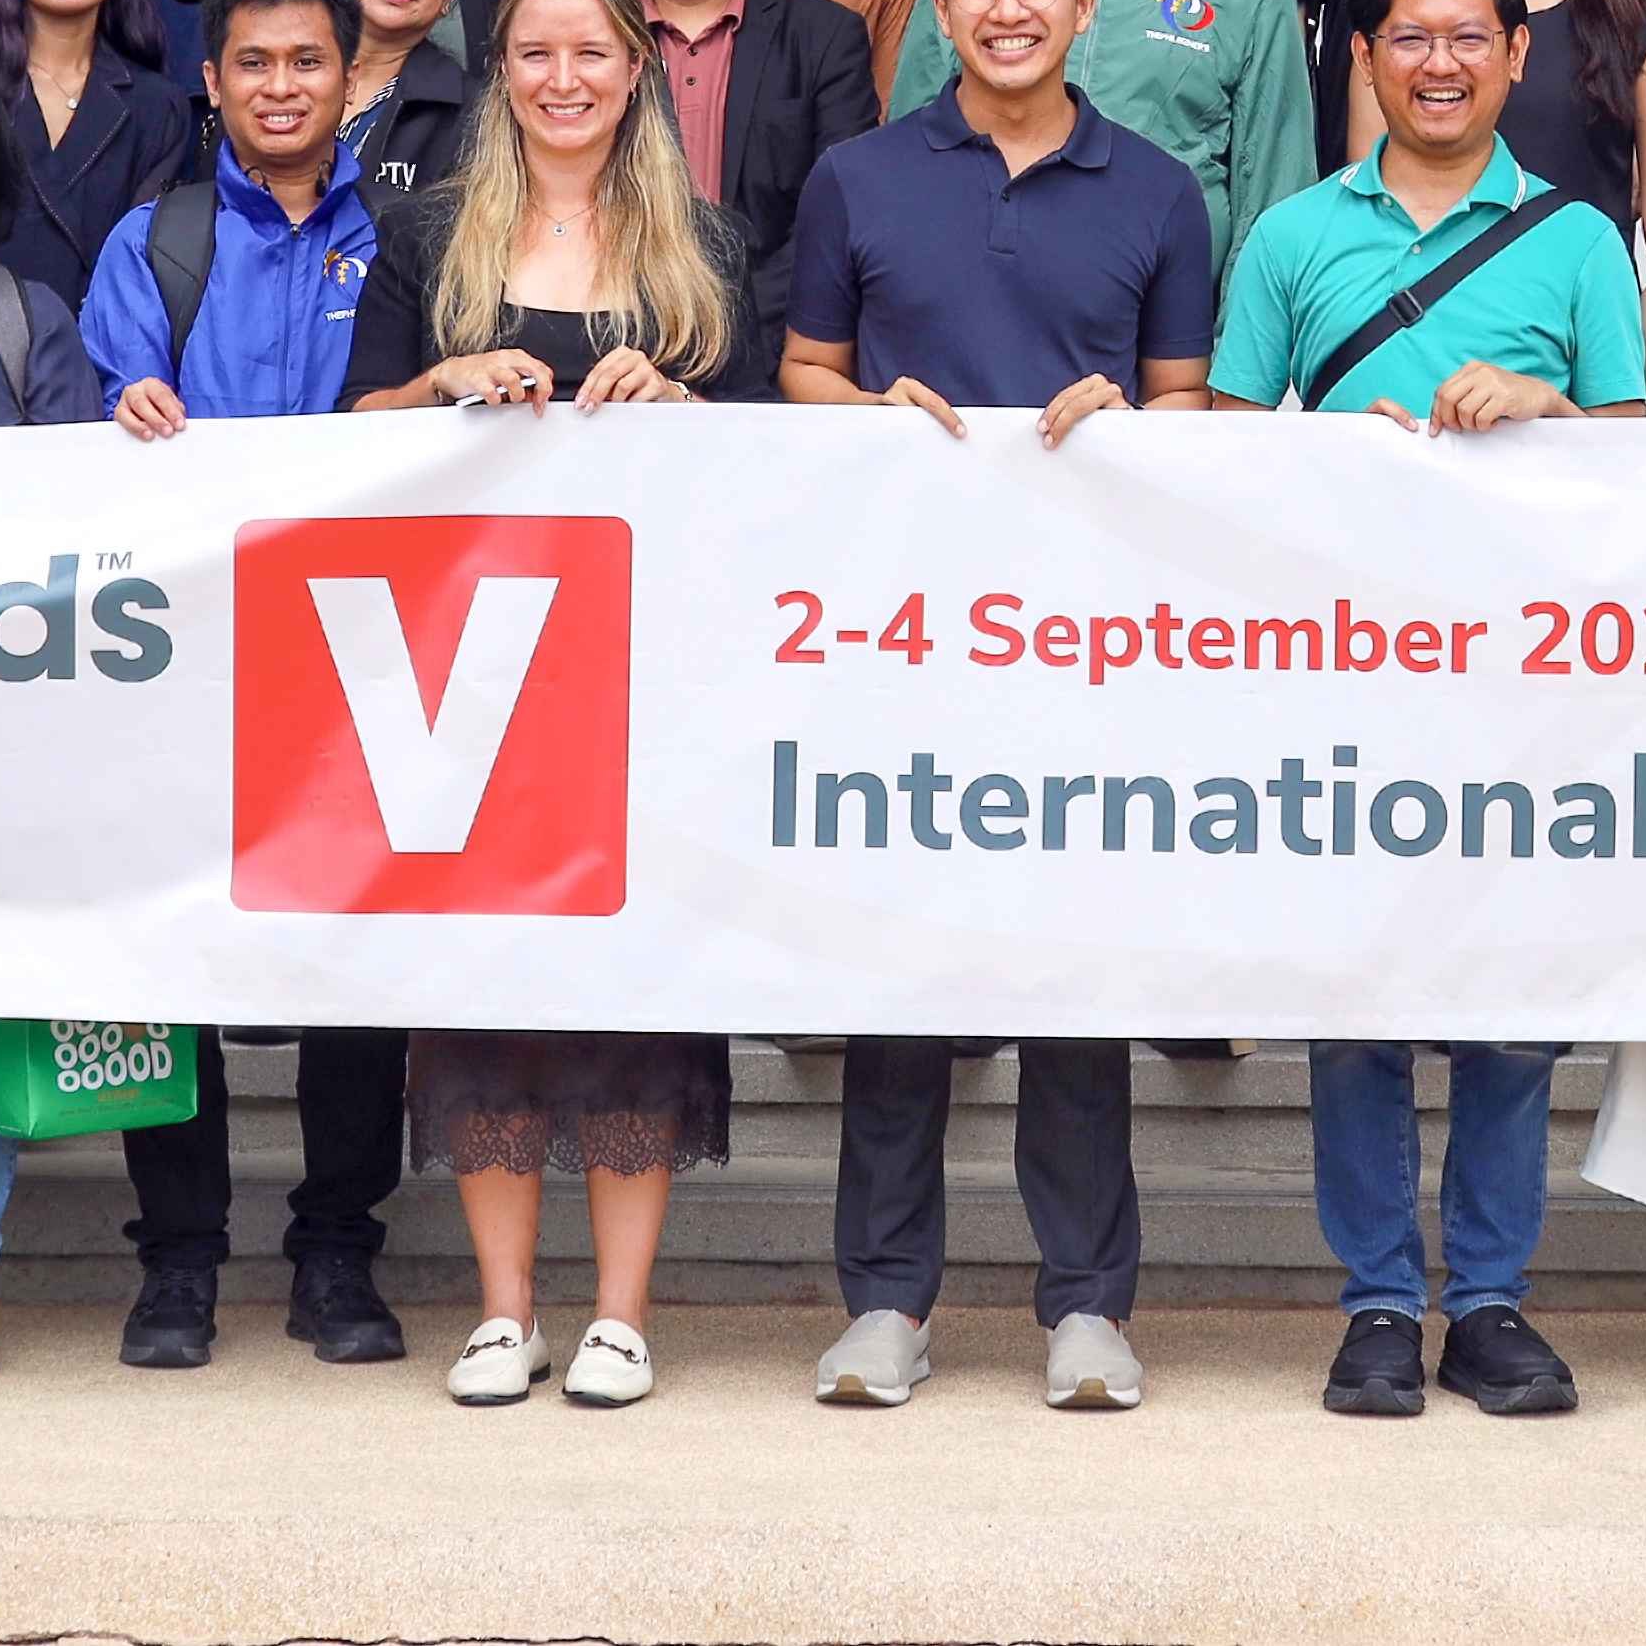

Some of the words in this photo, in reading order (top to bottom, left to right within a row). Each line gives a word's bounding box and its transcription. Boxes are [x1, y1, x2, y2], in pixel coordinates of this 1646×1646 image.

[306, 576, 560, 853] V
[775, 589, 934, 666] 2-4
[969, 593, 1488, 686] September
